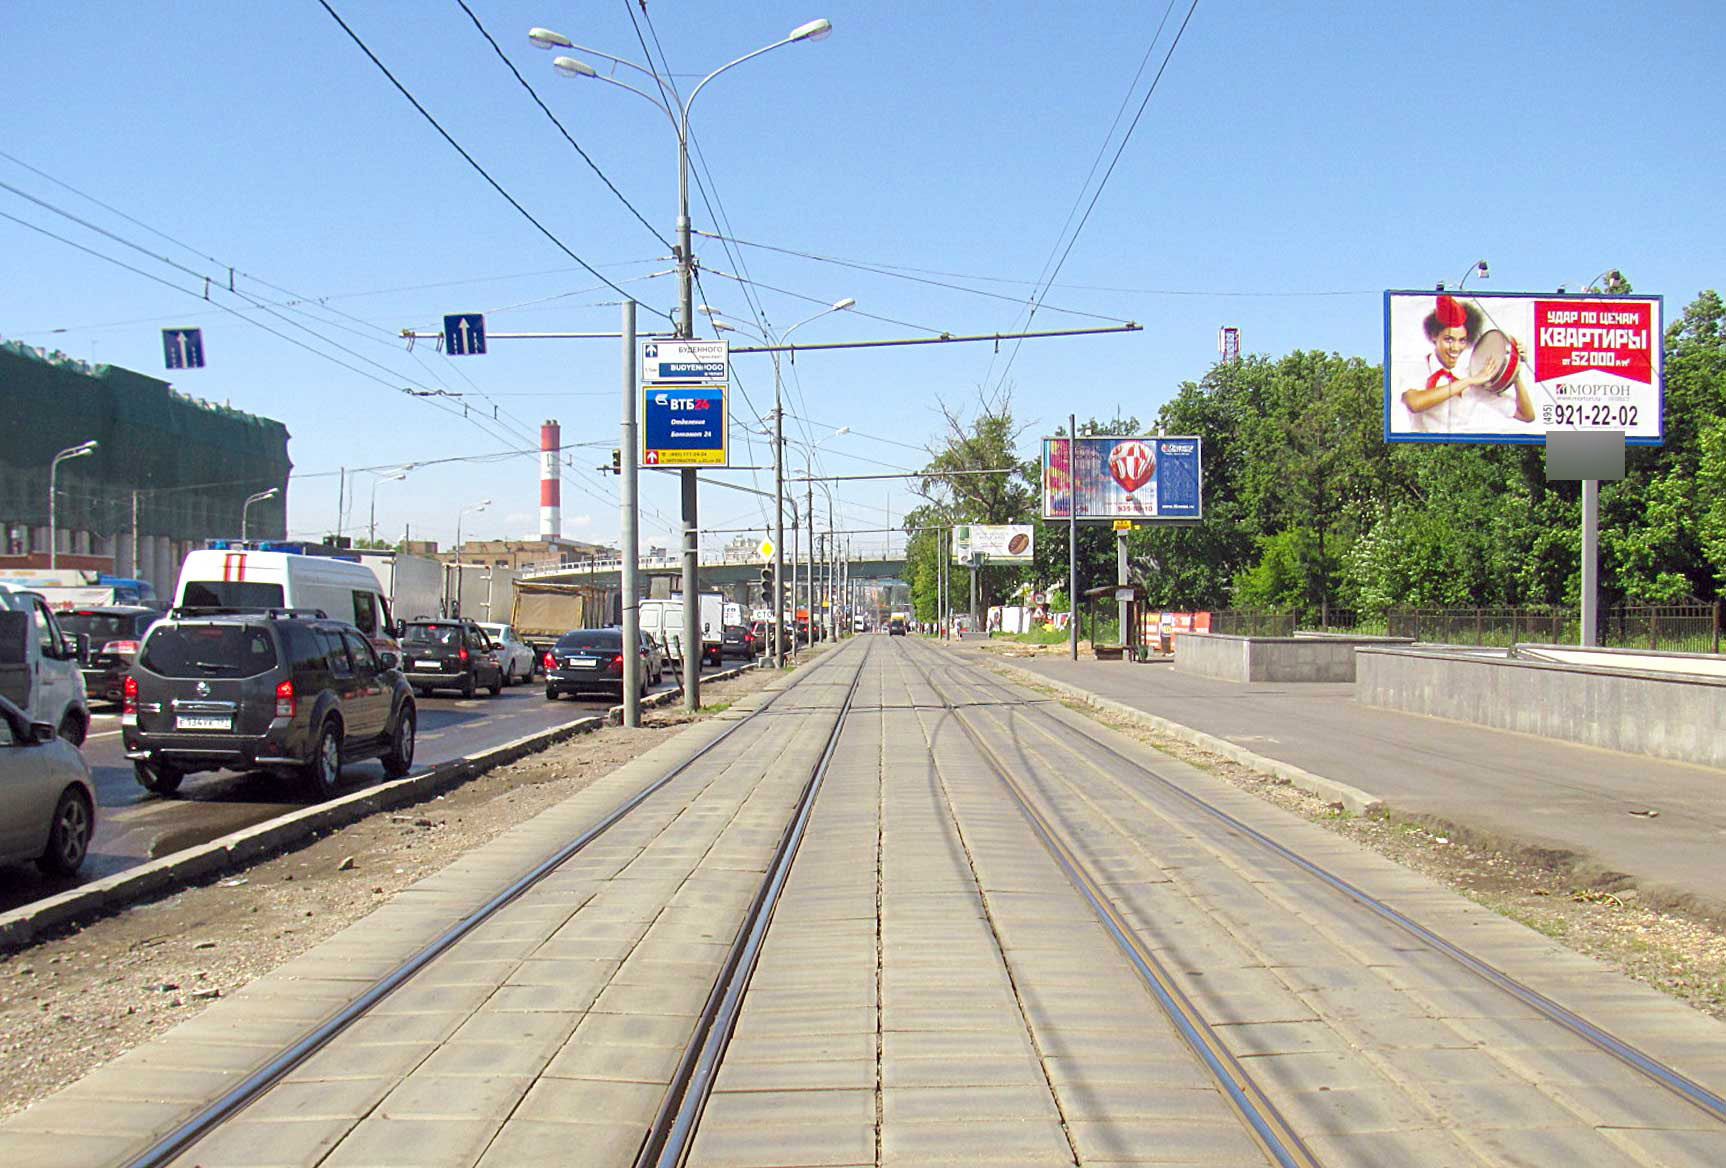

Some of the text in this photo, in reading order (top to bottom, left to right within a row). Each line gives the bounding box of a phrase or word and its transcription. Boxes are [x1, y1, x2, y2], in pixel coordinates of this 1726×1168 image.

[1547, 311, 1638, 325] УДАР ПО ЦЕНАМ
[1540, 327, 1647, 349] КВАРТИРЫ
[1569, 384, 1631, 396] МОРТОН
[1555, 404, 1638, 426] 921-22-02
